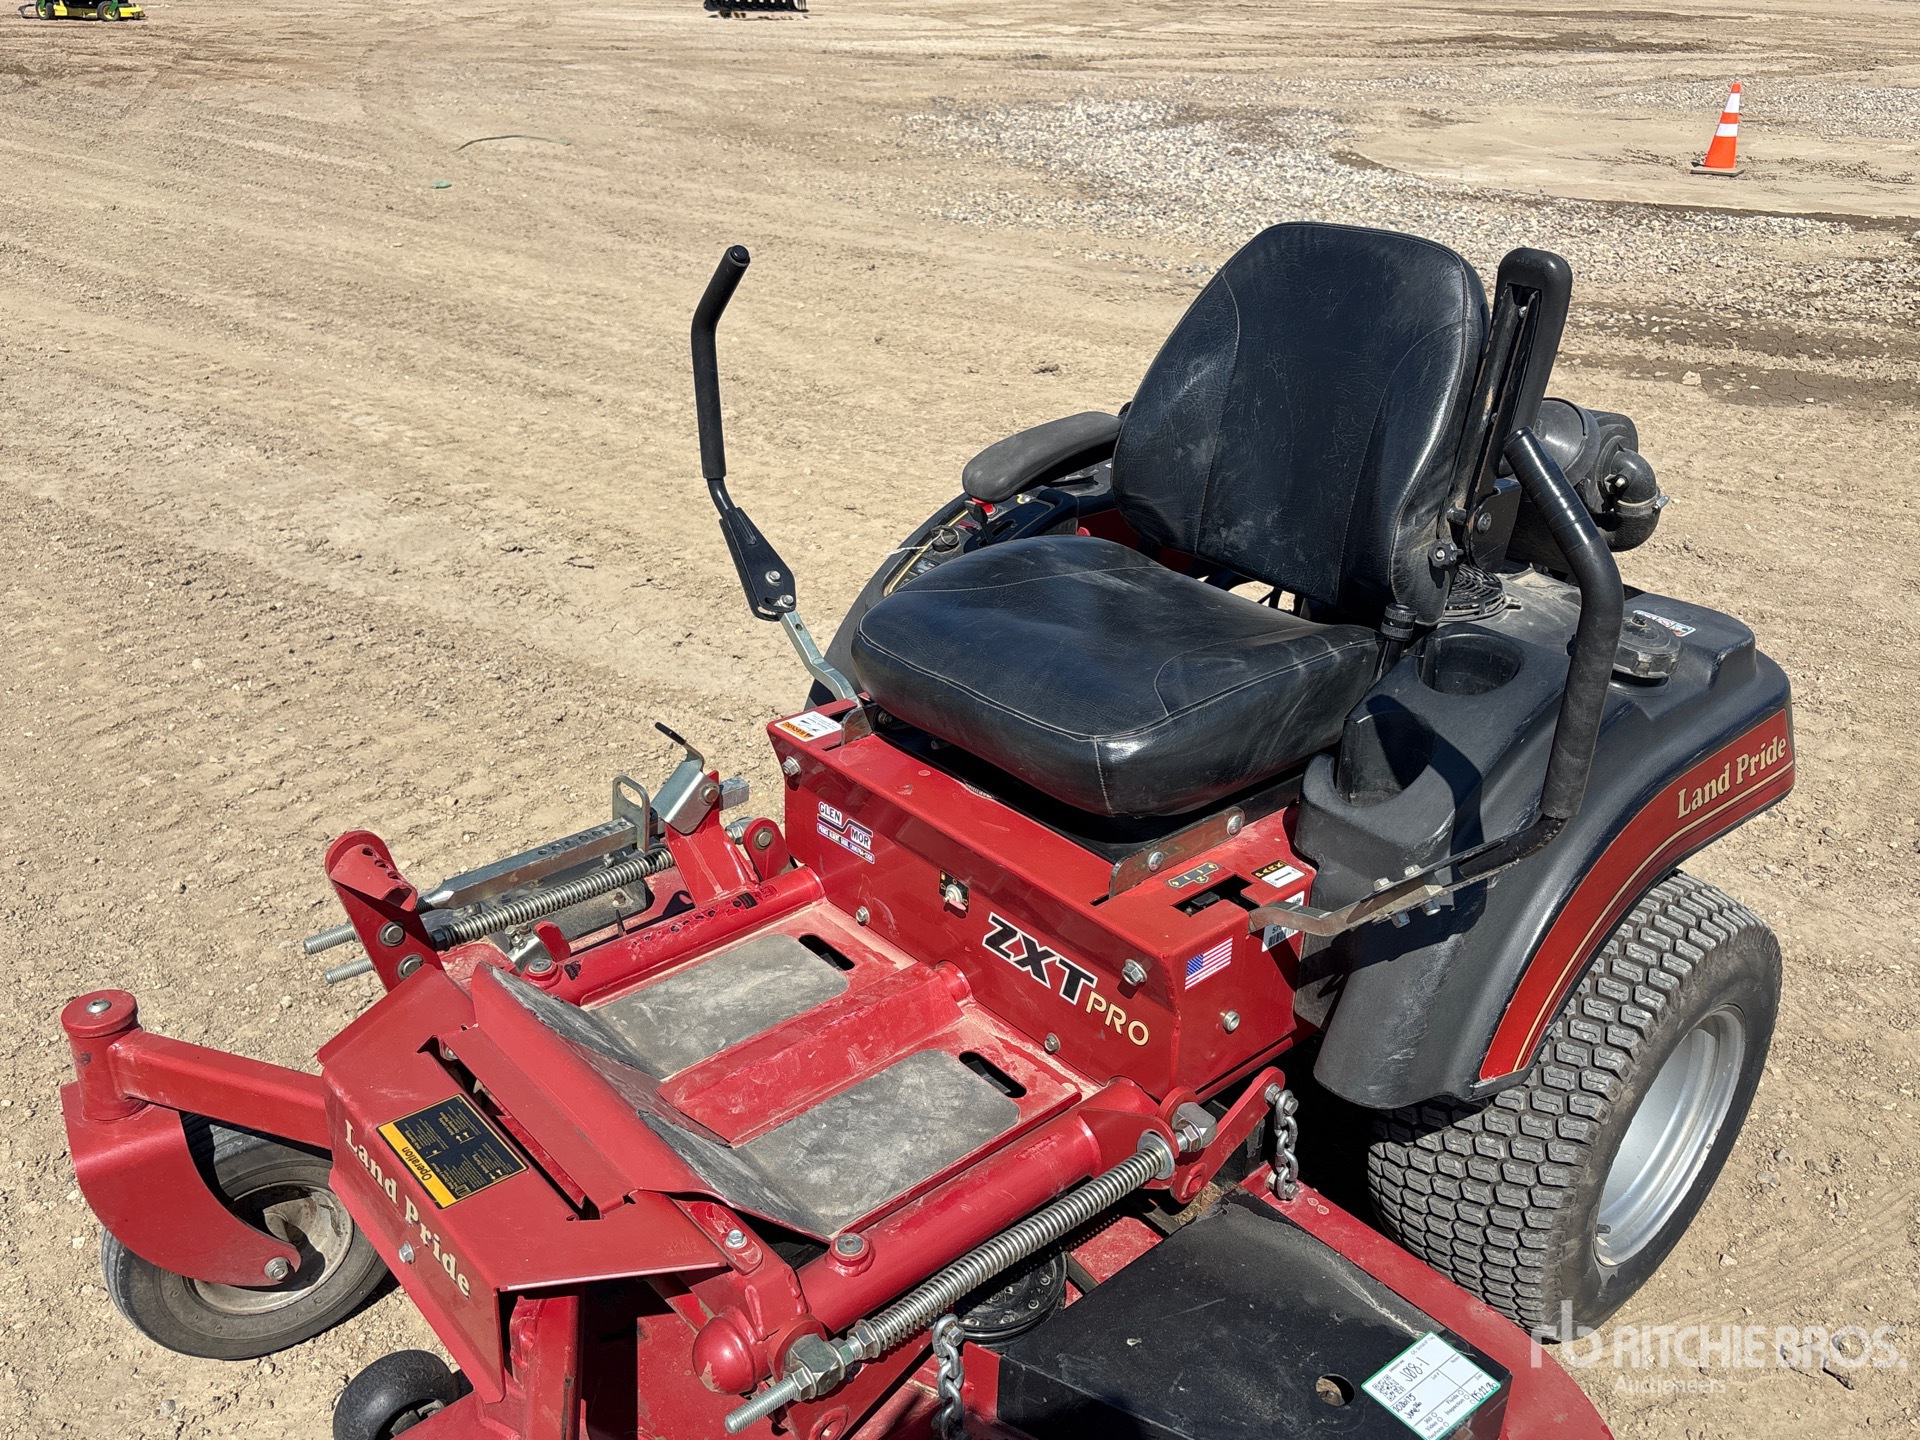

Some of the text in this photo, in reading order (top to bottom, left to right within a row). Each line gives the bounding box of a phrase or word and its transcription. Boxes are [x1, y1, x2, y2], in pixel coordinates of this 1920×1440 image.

[1677, 735, 1787, 820] Land Pride
[819, 802, 841, 823] GLEN
[852, 828, 870, 847] MOR
[1255, 862, 1284, 877] PARK
[982, 911, 1150, 1046] ZXT PRO
[402, 1146, 432, 1181] Operation
[345, 1119, 399, 1205] Land
[404, 1195, 471, 1299] Pride
[1444, 1398, 1465, 1415] Inspection
